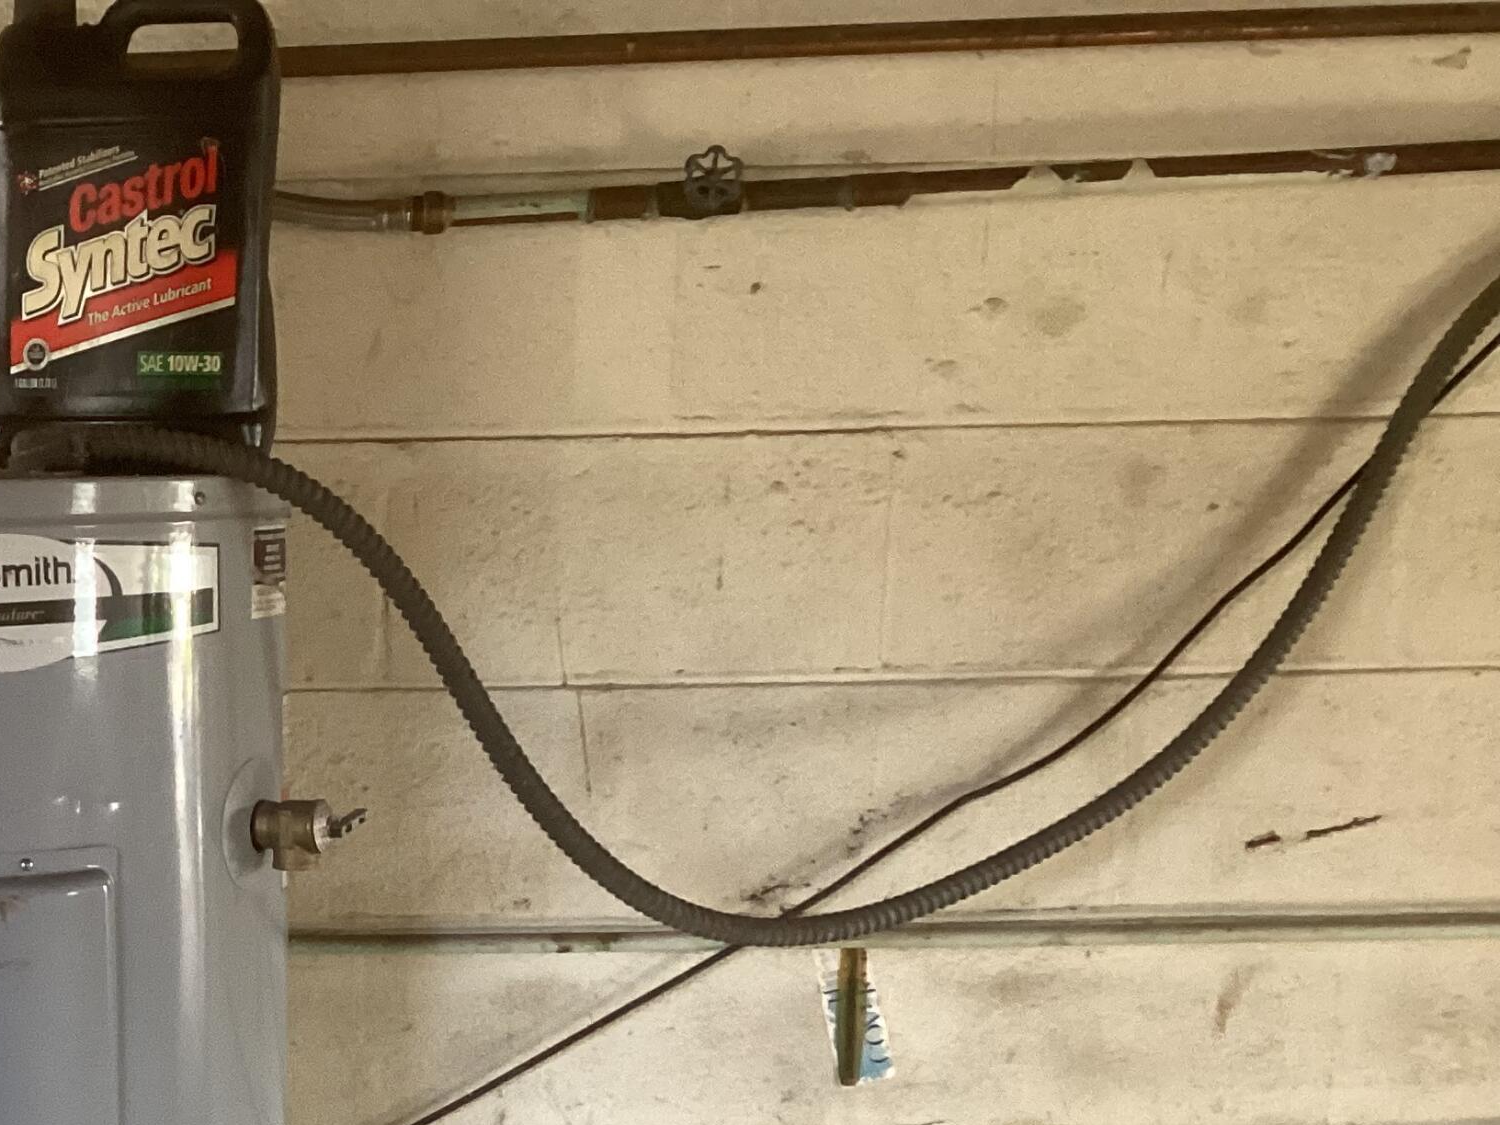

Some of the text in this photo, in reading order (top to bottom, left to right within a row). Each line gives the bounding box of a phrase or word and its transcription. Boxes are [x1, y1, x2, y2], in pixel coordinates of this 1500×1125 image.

[69, 143, 217, 233] Castrol
[22, 204, 216, 326] Syntec
[88, 278, 212, 326] The Active Lubricant
[140, 355, 221, 373] SAE 10W-30
